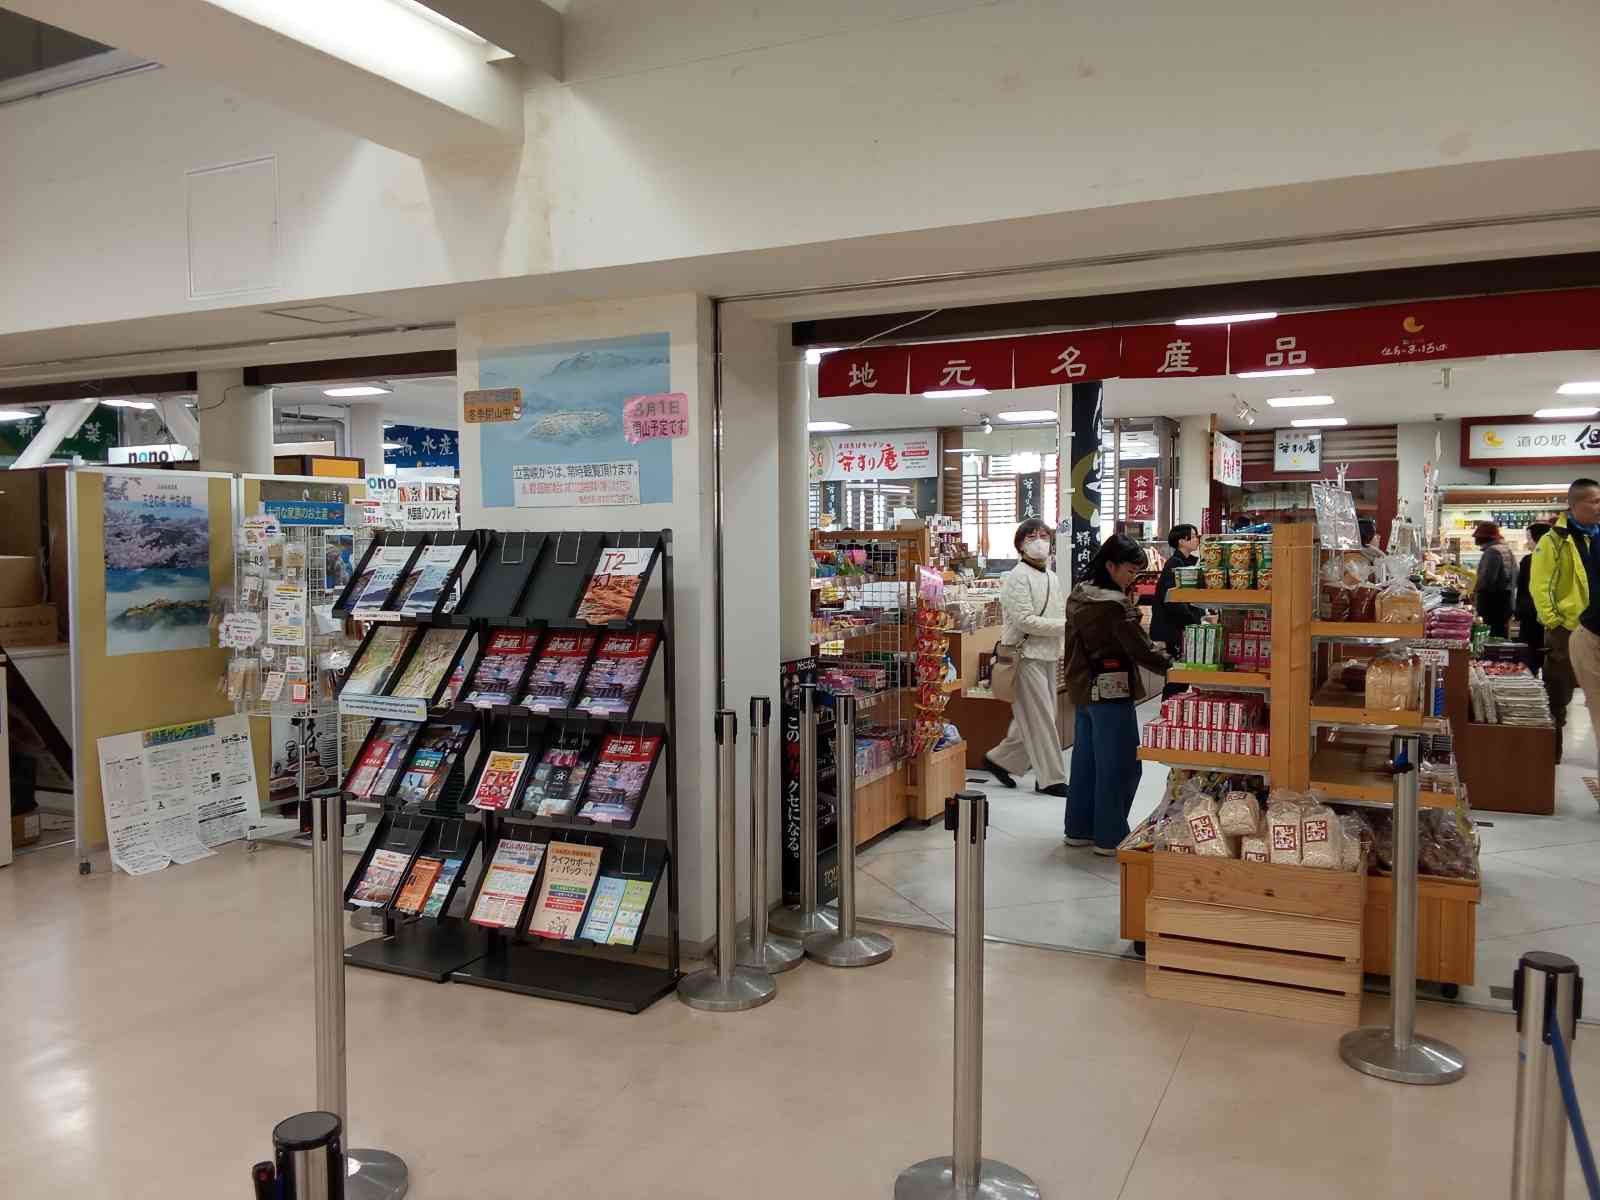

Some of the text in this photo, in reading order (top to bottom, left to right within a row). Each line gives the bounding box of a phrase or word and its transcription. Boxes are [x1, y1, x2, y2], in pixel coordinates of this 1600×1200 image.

[848, 335, 1307, 389] 地元名産品
[1515, 434, 1567, 449] 道の駅
[128, 450, 169, 464] nono
[1134, 474, 1149, 515] 食事処
